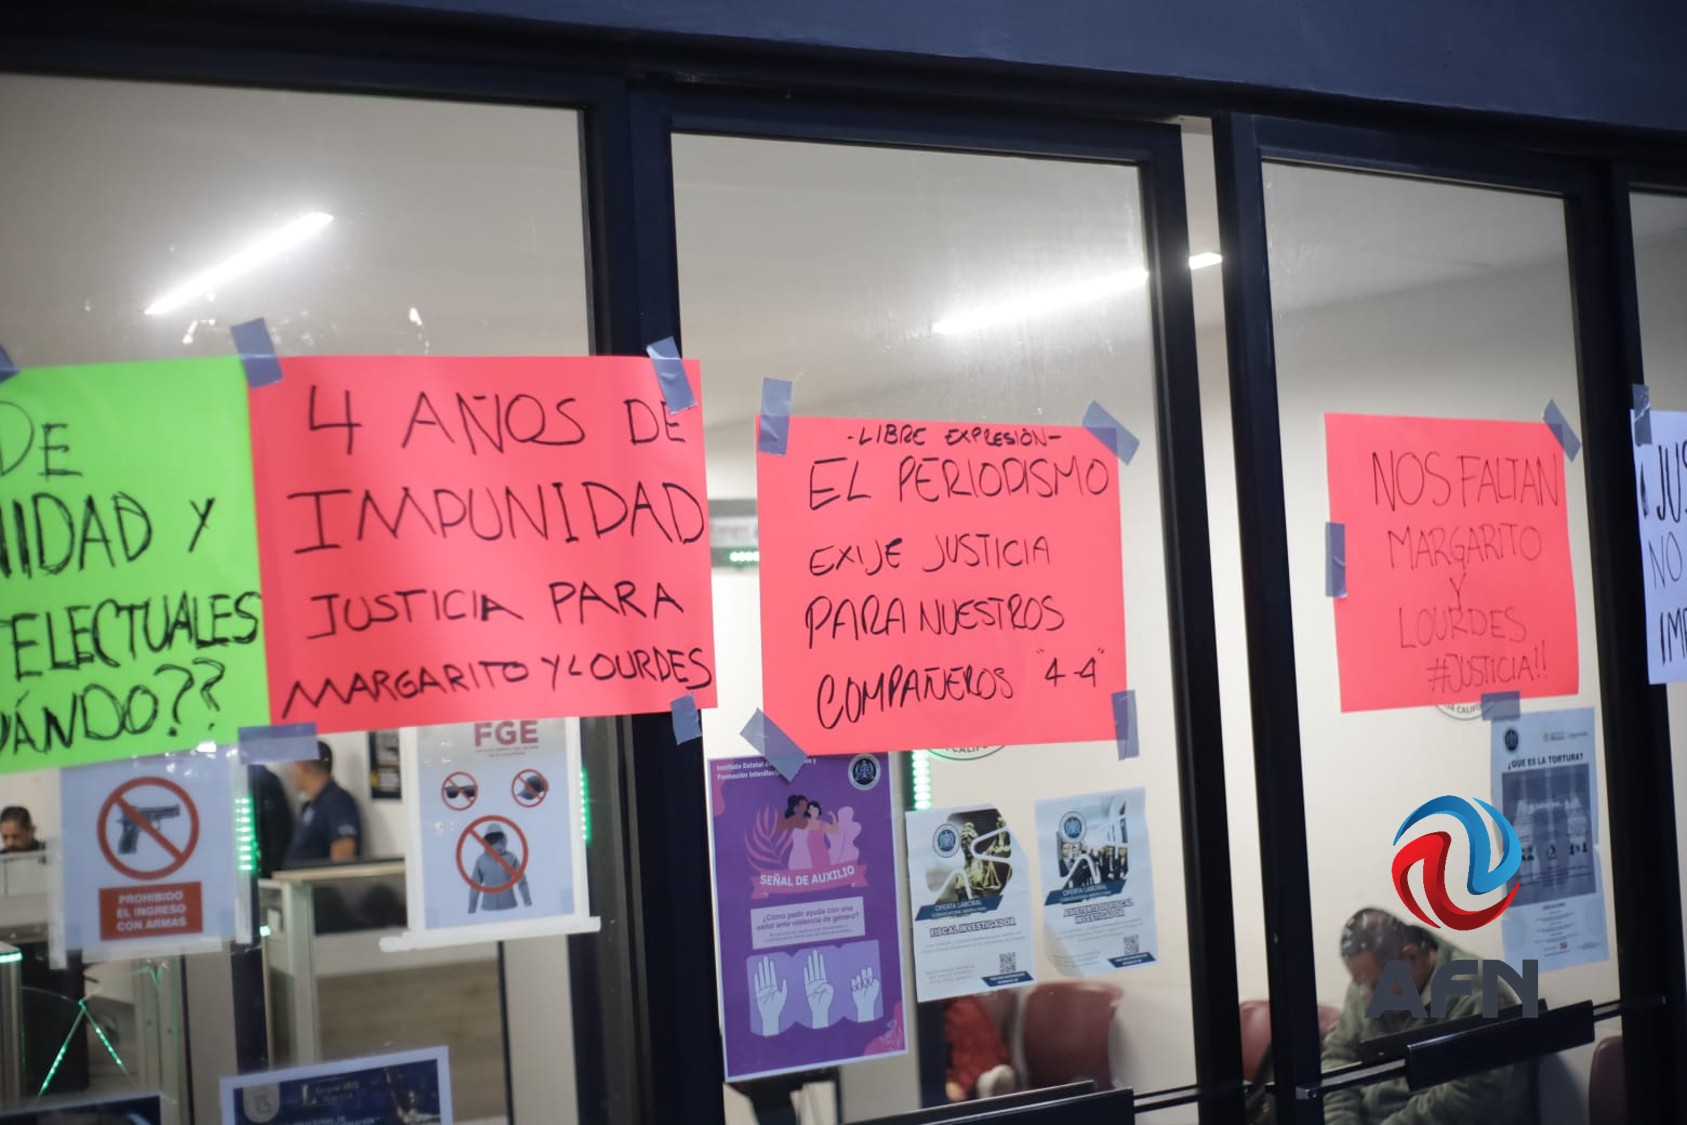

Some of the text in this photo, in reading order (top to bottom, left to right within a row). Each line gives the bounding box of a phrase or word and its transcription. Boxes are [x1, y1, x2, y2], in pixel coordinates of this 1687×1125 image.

[309, 384, 685, 455] 4 AÑOS DE
[809, 455, 1109, 511] EL PERIODISMO
[1371, 450, 1559, 512] NOS FALTAN
[188, 497, 216, 553] Y
[286, 480, 705, 554] IMPUNIDAD
[809, 533, 1051, 576] EXIJE JUSTICIA
[1387, 522, 1543, 570] MARGARITO
[1648, 531, 1682, 589] NO
[306, 580, 684, 640] JUSTICIA PARA
[1449, 572, 1466, 612] Y
[805, 593, 1065, 649] PARA NUESTROS
[1399, 605, 1528, 650] LOURDES
[282, 660, 529, 719] MARGARITO
[817, 664, 1014, 729] COMPAÑEROS
[474, 720, 539, 747] FGE
[118, 890, 184, 905] PROHIBIDO
[760, 865, 855, 887] SEÑAL DE AUXILIO
[116, 903, 187, 918] EL INGRESO
[116, 916, 188, 932] CON ARMAS
